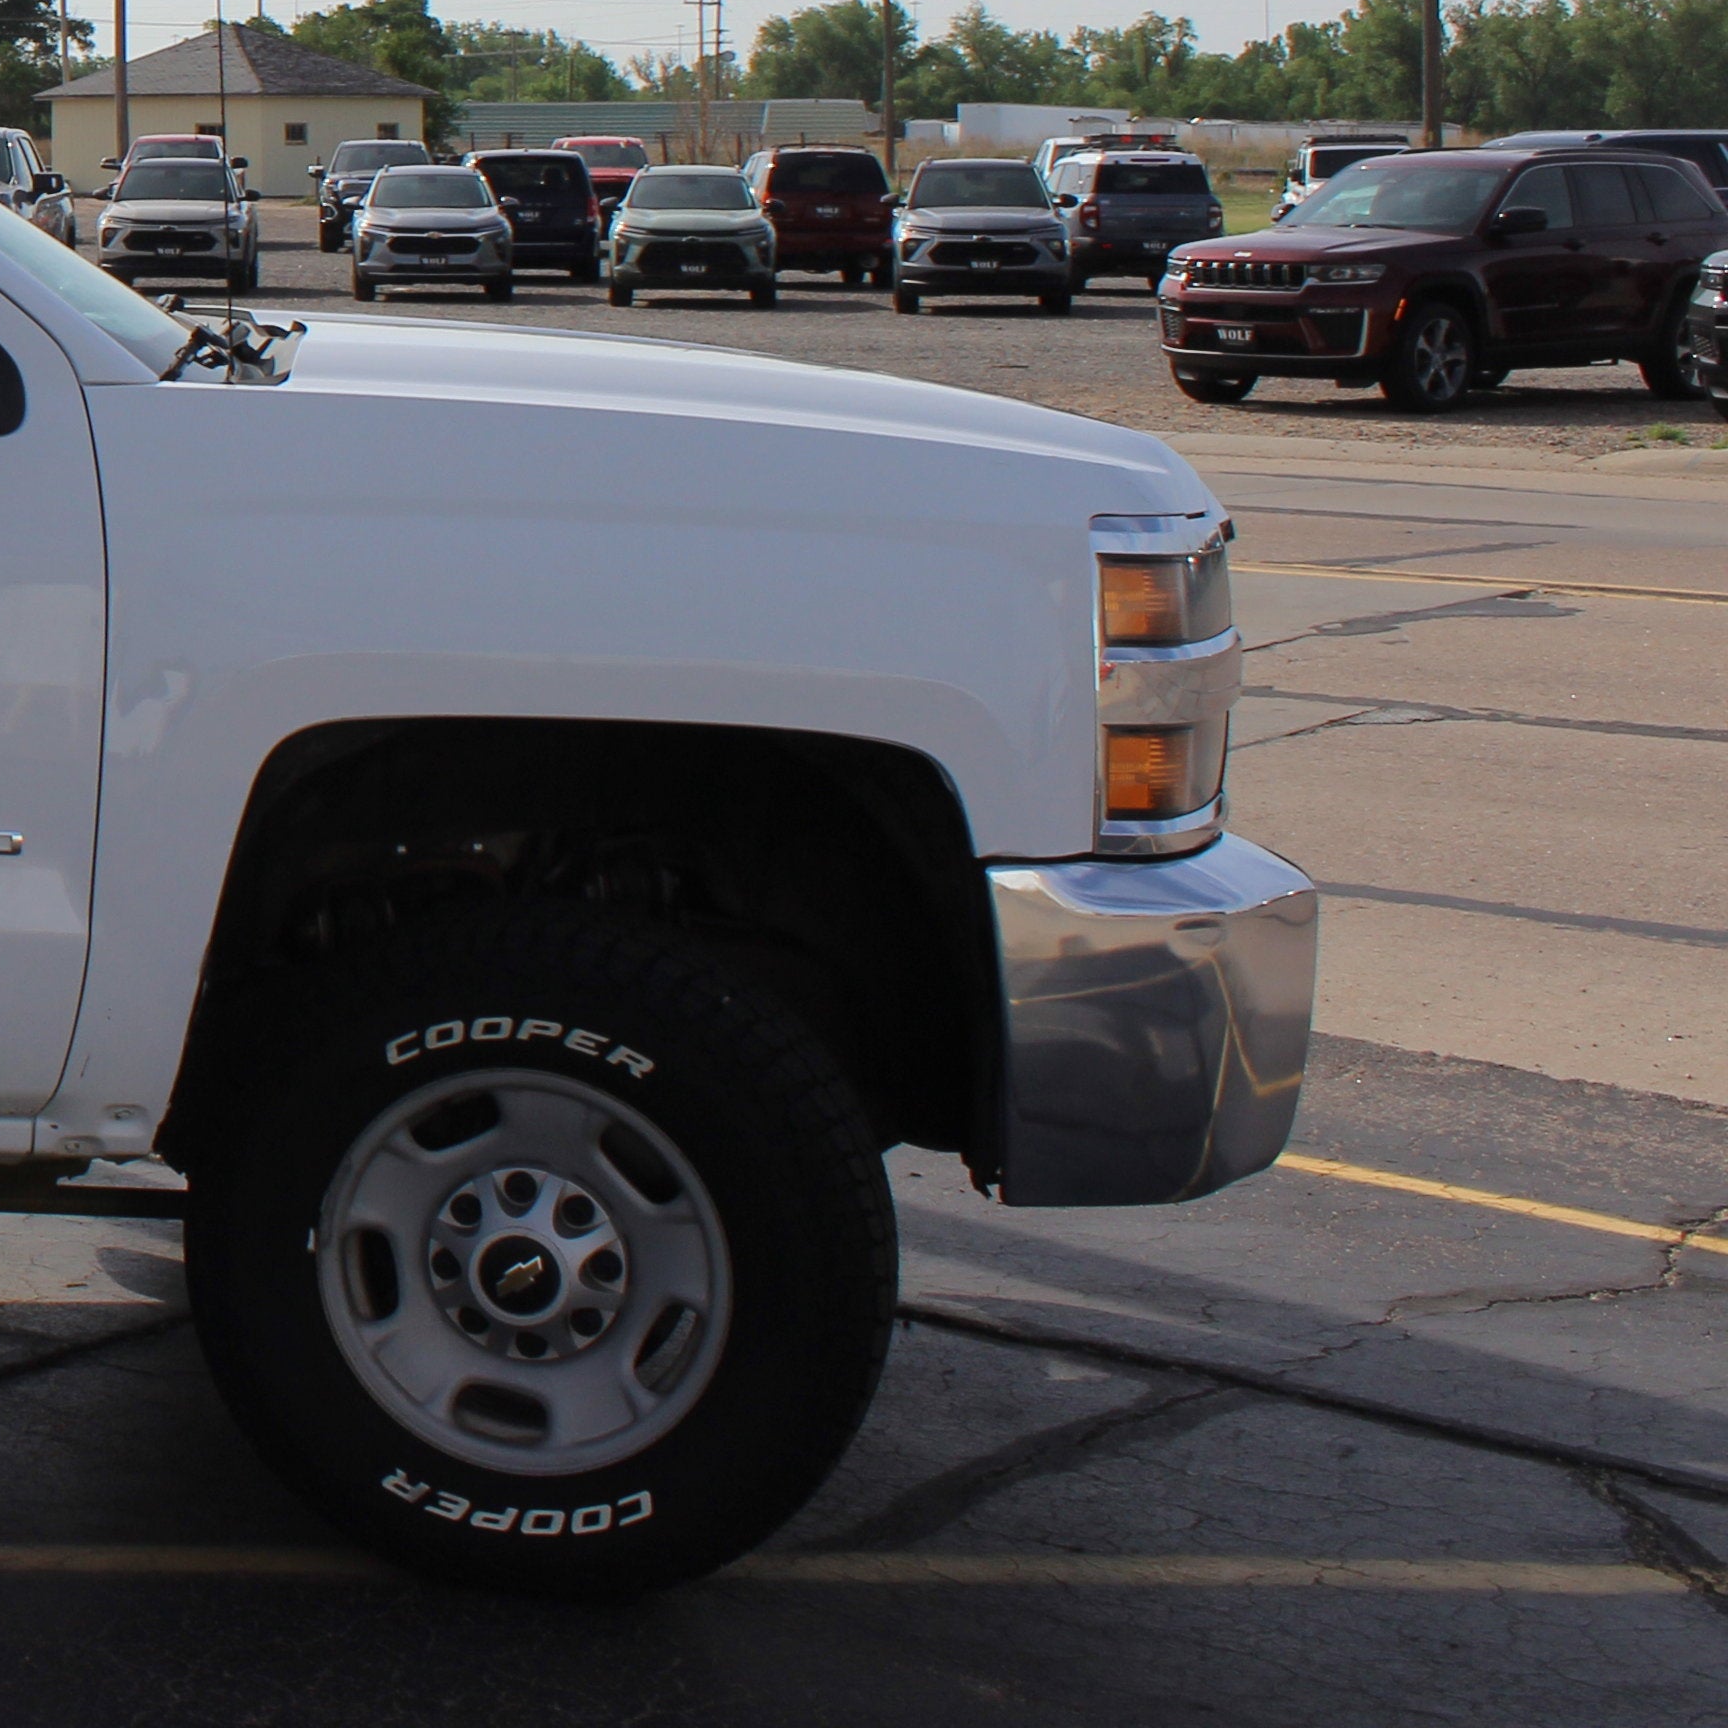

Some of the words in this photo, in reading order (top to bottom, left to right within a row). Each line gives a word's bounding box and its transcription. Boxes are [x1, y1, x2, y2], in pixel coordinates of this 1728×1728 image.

[1216, 328, 1253, 341] WOLF
[385, 1016, 656, 1079] COOPER
[381, 1468, 654, 1536] COOPER
